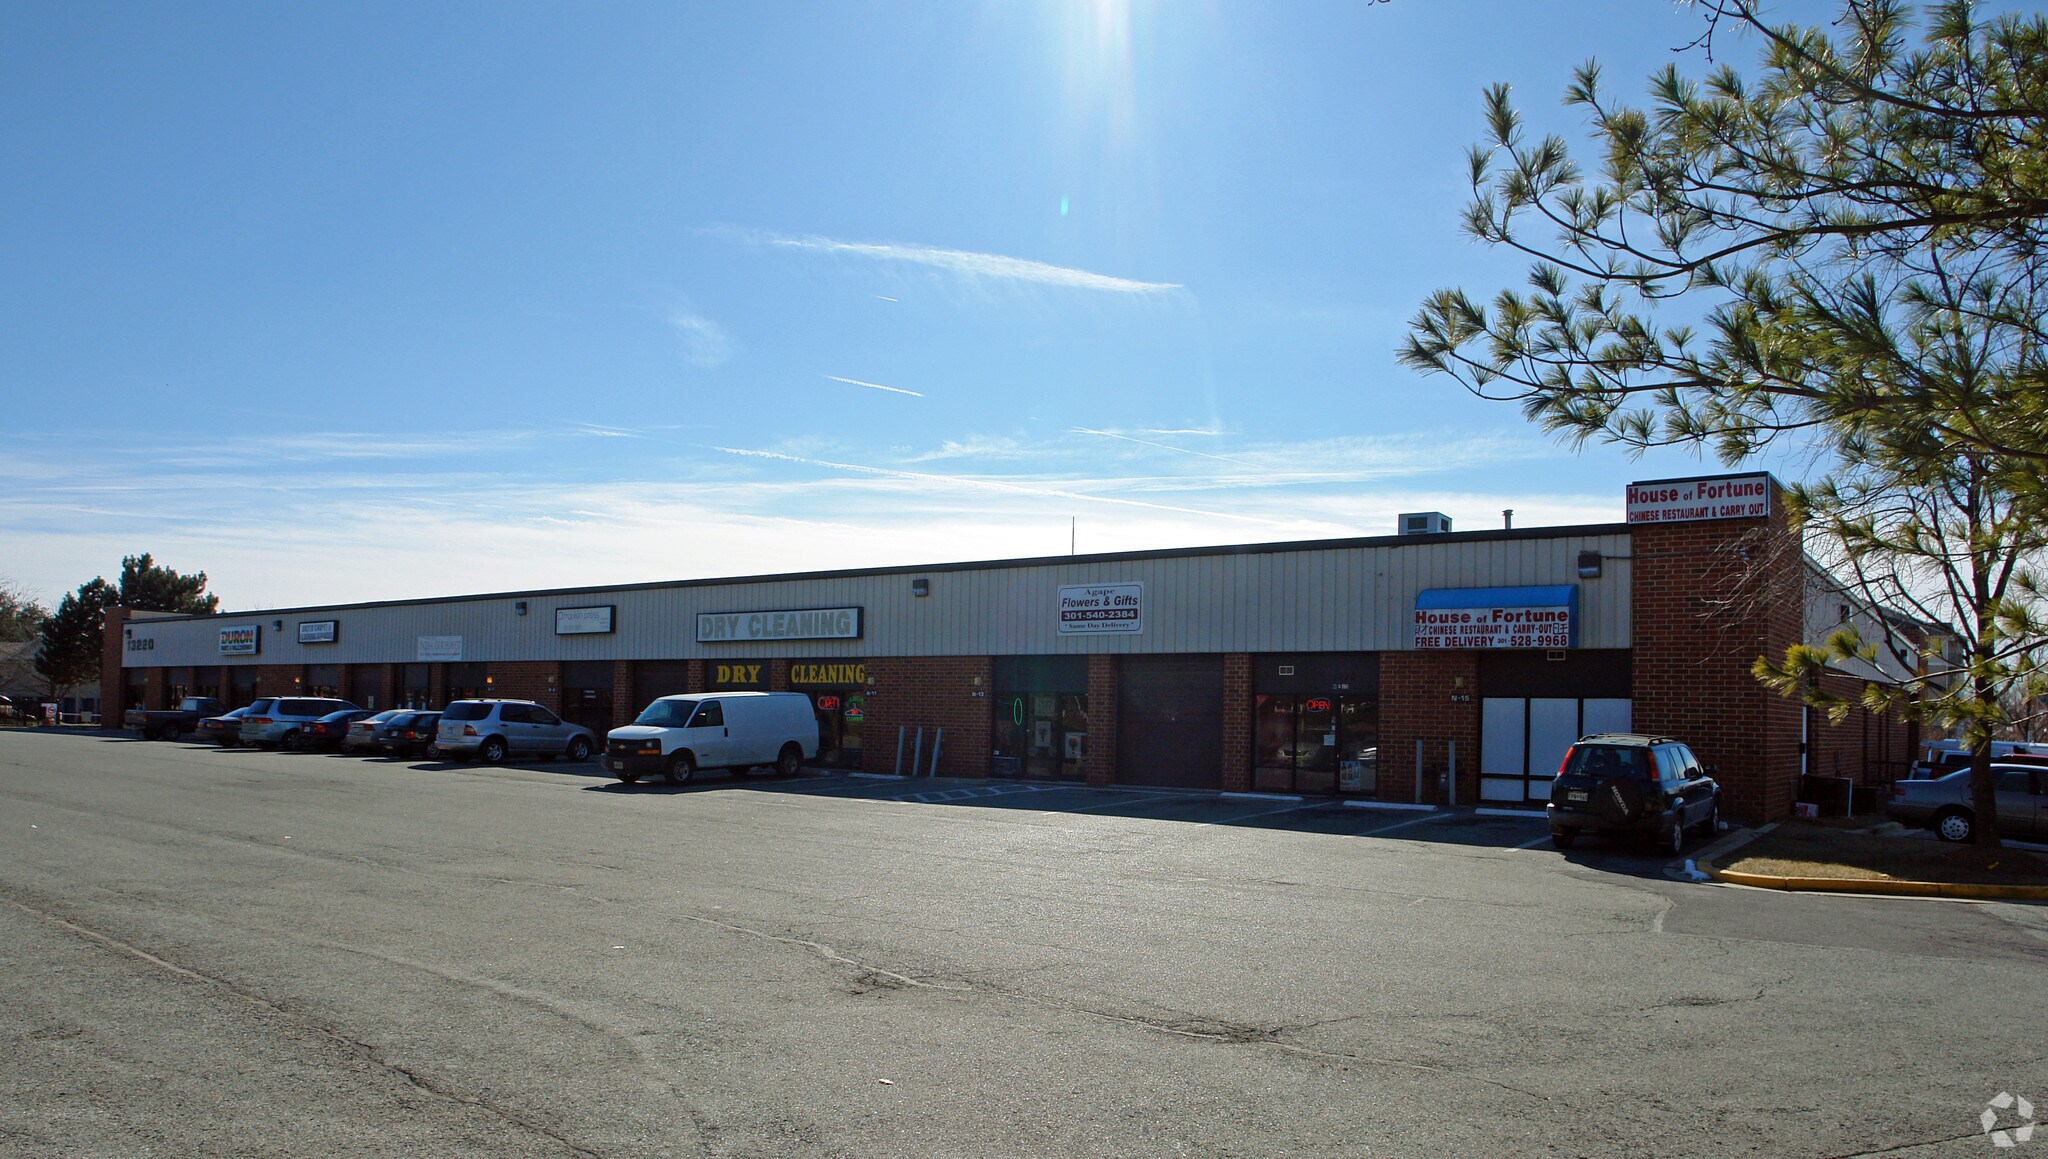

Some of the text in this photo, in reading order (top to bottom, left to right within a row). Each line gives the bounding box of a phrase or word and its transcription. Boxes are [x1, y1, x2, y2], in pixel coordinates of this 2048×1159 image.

[1628, 482, 1765, 504] House of Fortune
[1629, 503, 1764, 522] CHINESE RESTAURANT & CARRY OUT
[1084, 588, 1115, 597] Agape
[1062, 595, 1138, 608] Flowers & Gifts
[1064, 610, 1135, 620] 301-540-2384
[1415, 609, 1568, 624] House of Fortune
[701, 611, 851, 639] DRY CLEANING
[1087, 622, 1100, 630] Day
[1101, 621, 1130, 629] Delivery
[1429, 624, 1552, 635] CHINESE RESTAURANT & CARRY-OUT
[221, 630, 254, 645] DURON
[1415, 636, 1440, 647] FREE
[1444, 636, 1494, 647] DELIVERY
[127, 639, 154, 651] 13220
[716, 664, 865, 684] DRY CLEANING
[1305, 699, 1331, 710] OPEN
[1611, 785, 1629, 815] HONDA
